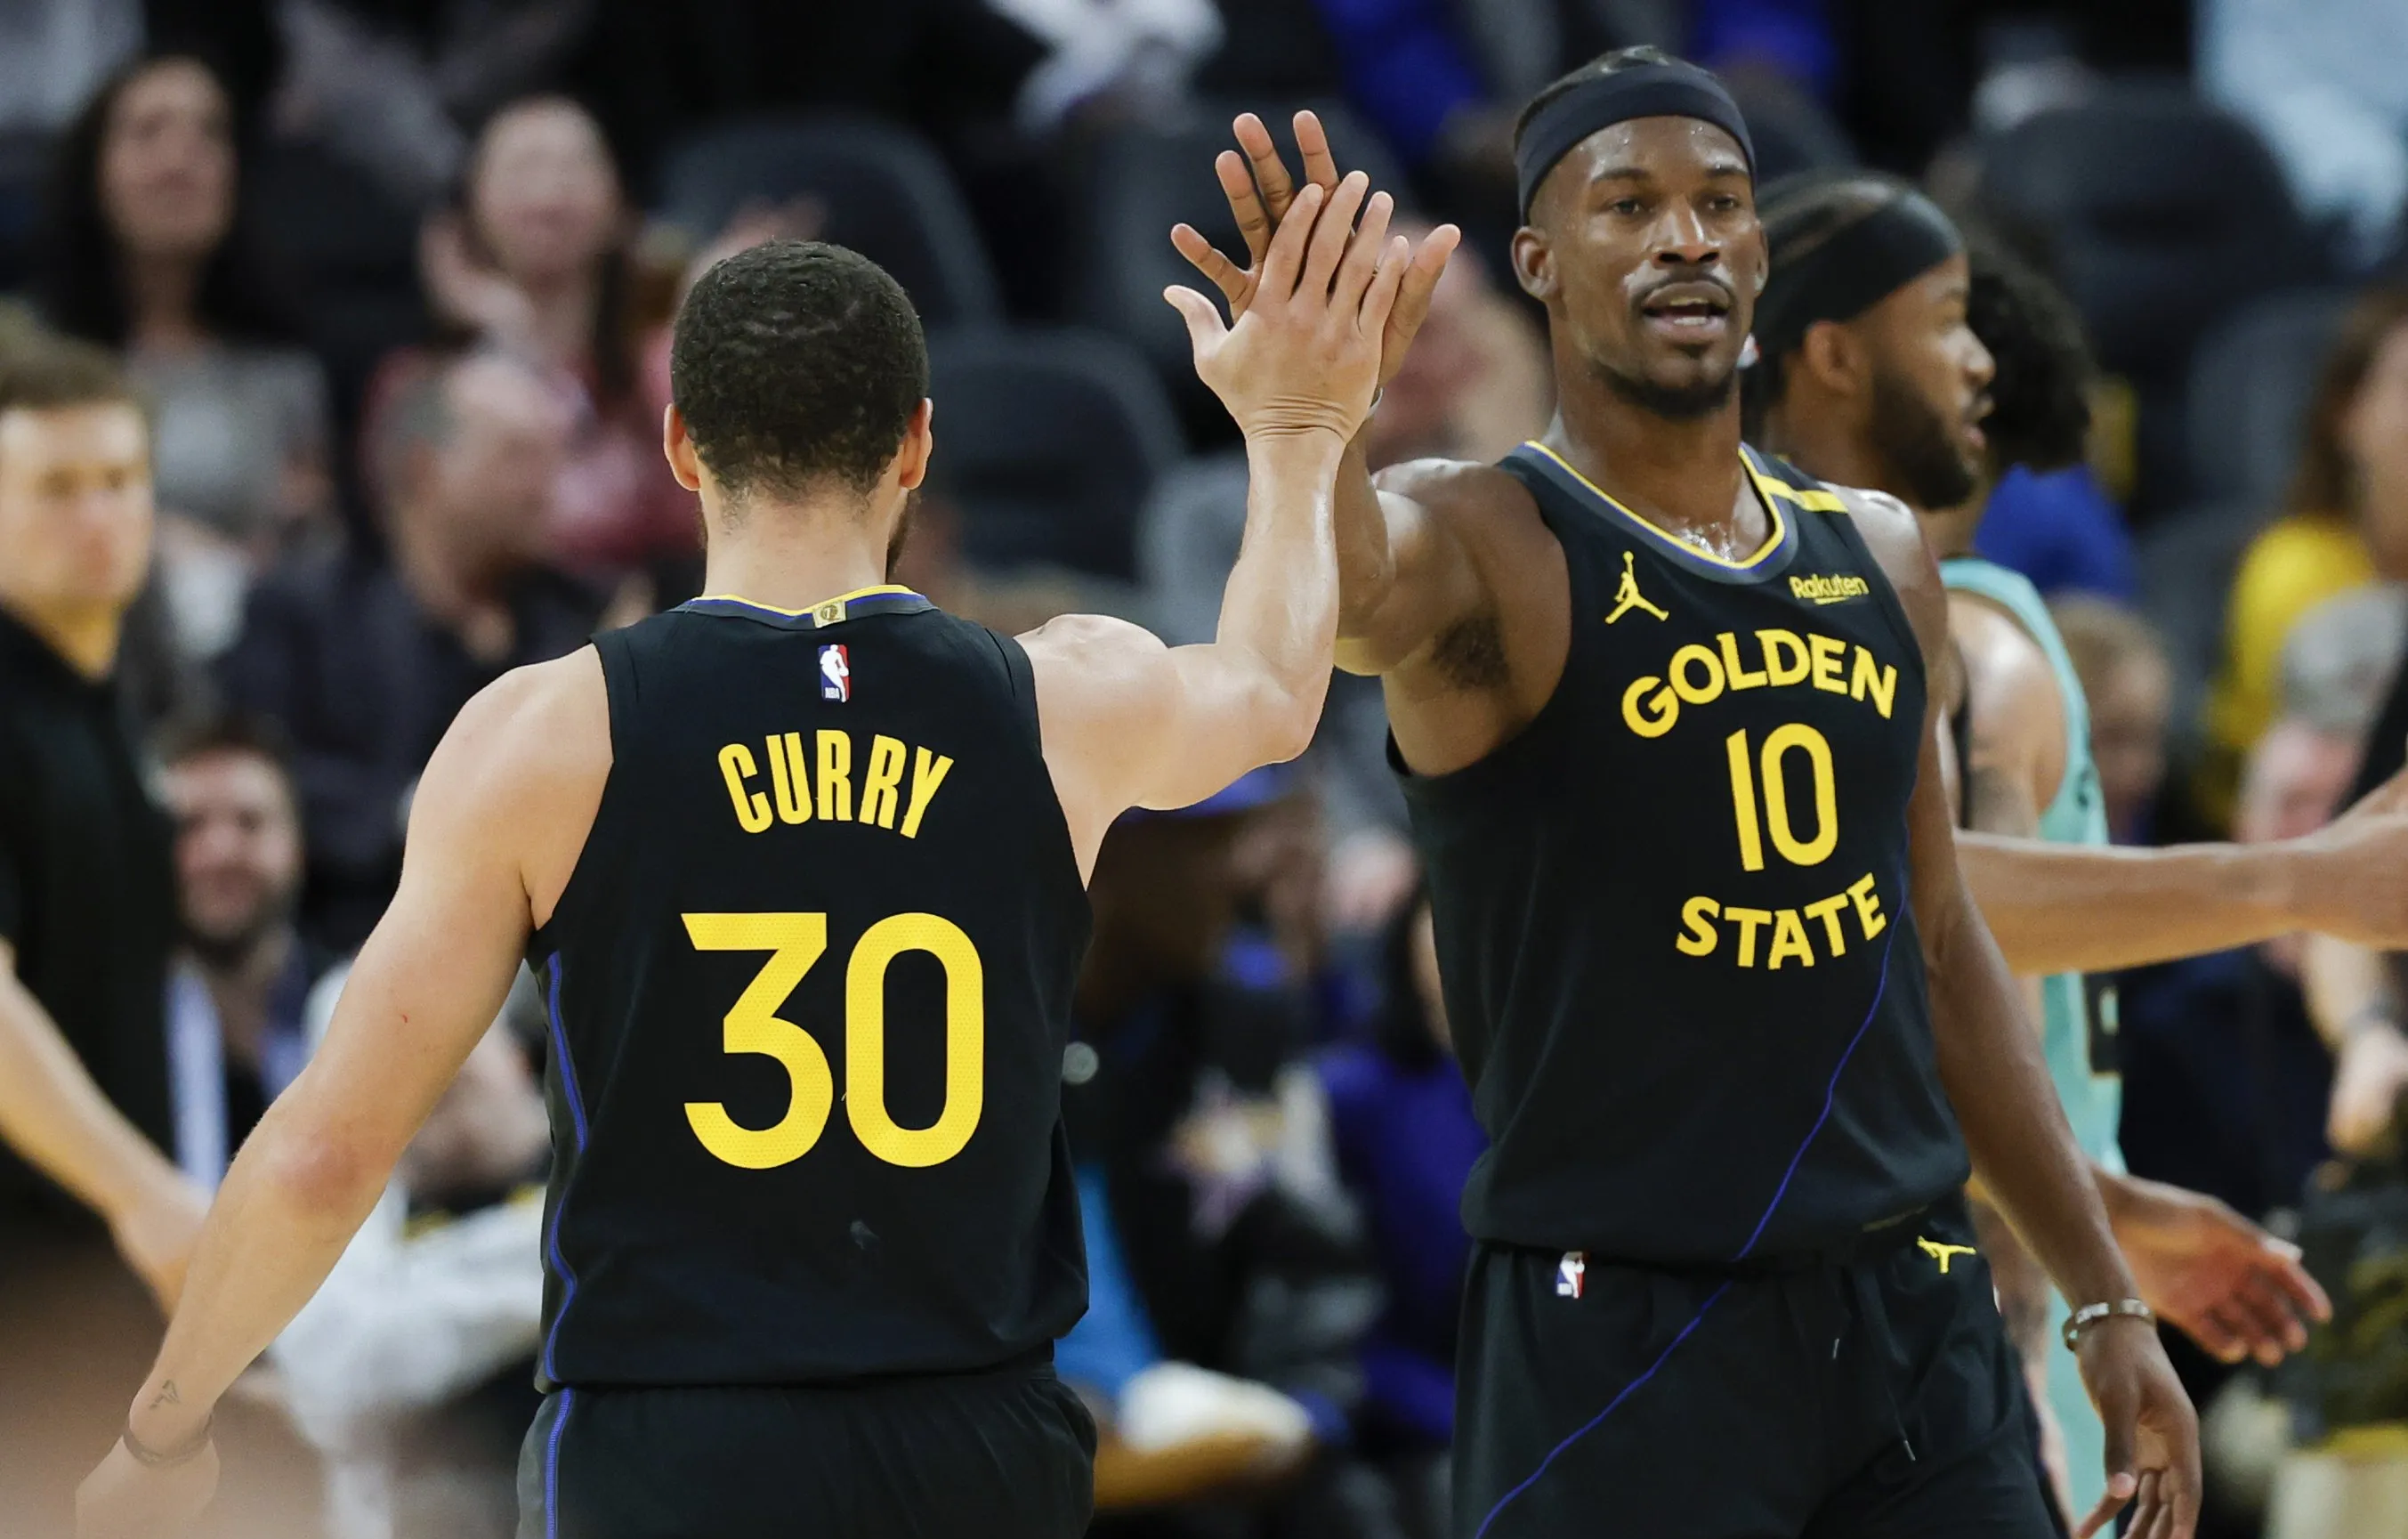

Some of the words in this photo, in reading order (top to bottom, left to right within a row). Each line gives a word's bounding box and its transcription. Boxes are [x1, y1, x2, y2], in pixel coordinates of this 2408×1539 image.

[1789, 573, 1870, 600] Rakuten
[1620, 628, 1898, 739] GOLDEN
[717, 729, 955, 838] CURRY
[1725, 722, 1839, 872] 10
[1675, 872, 1887, 971] STATE
[681, 911, 985, 1170] 30
